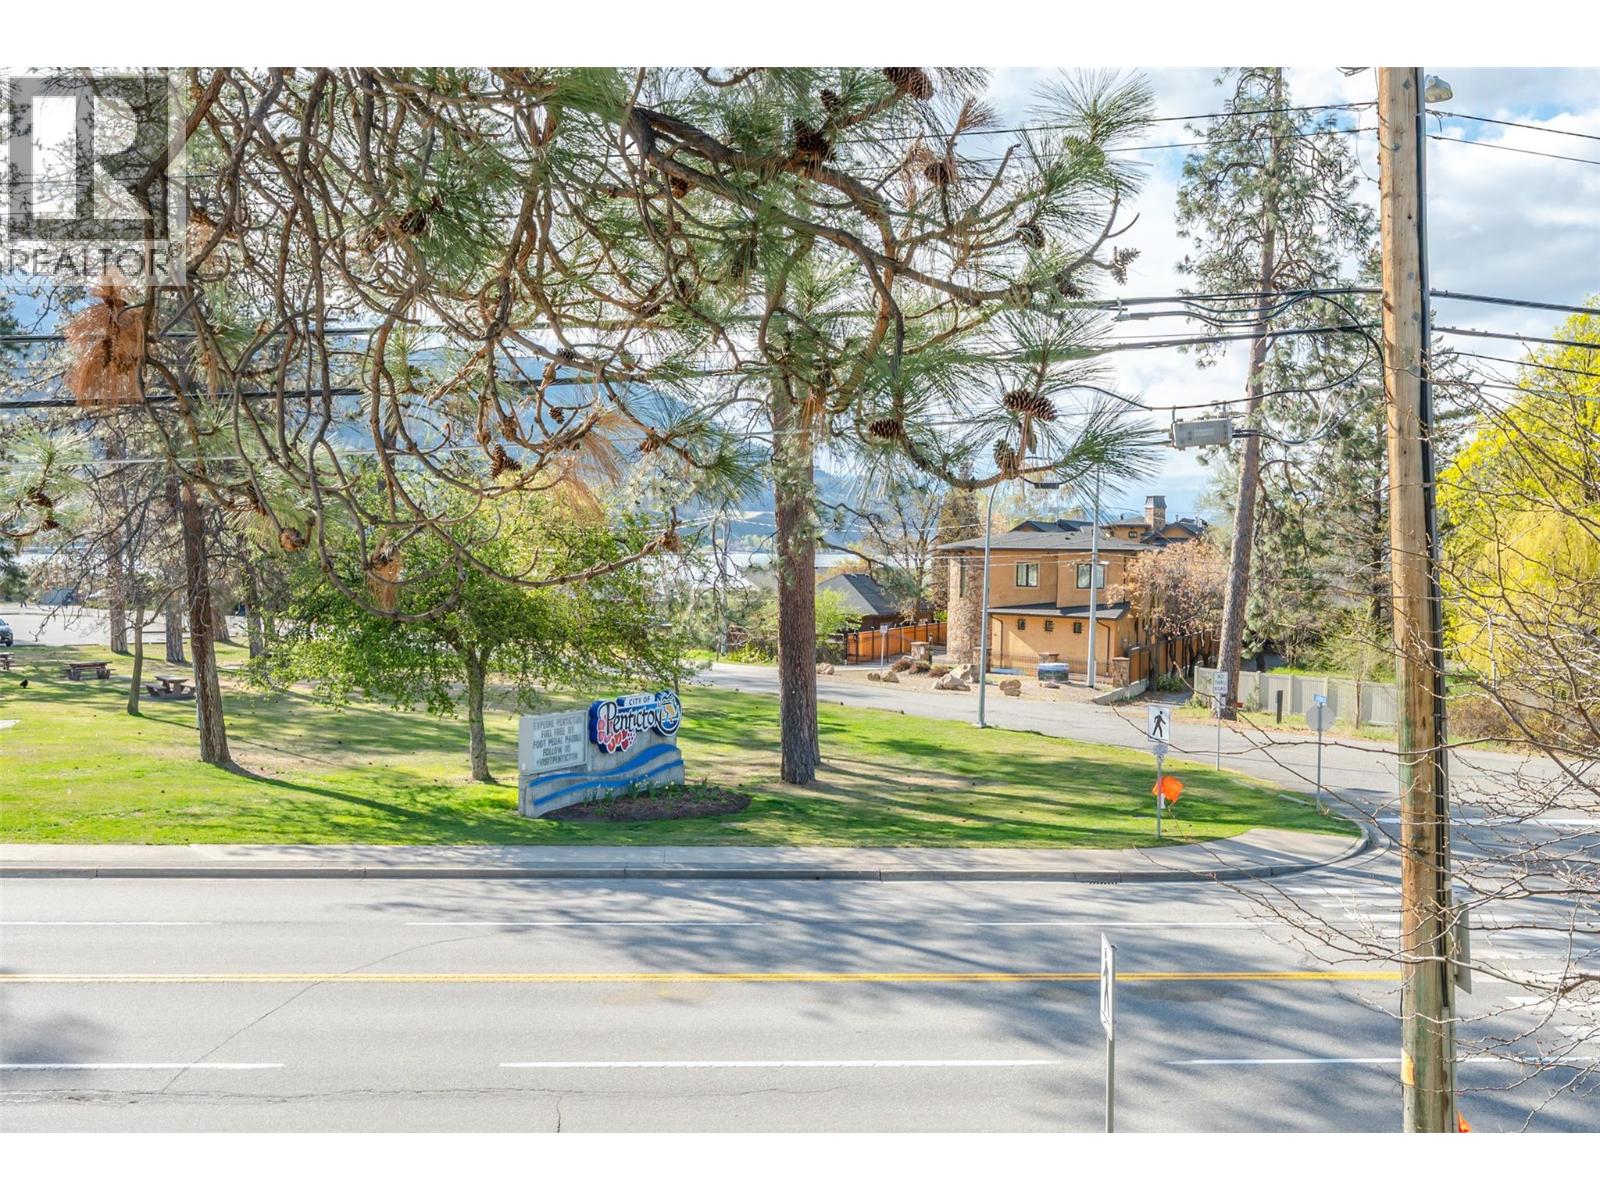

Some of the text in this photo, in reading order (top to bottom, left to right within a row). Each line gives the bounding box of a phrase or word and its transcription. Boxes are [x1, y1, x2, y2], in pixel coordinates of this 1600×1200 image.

[643, 695, 651, 703] OF
[598, 702, 664, 735] Penticton
[533, 739, 546, 749] FOOT
[543, 746, 562, 757] FOLLOW
[536, 752, 578, 766] VISITPENTIC
